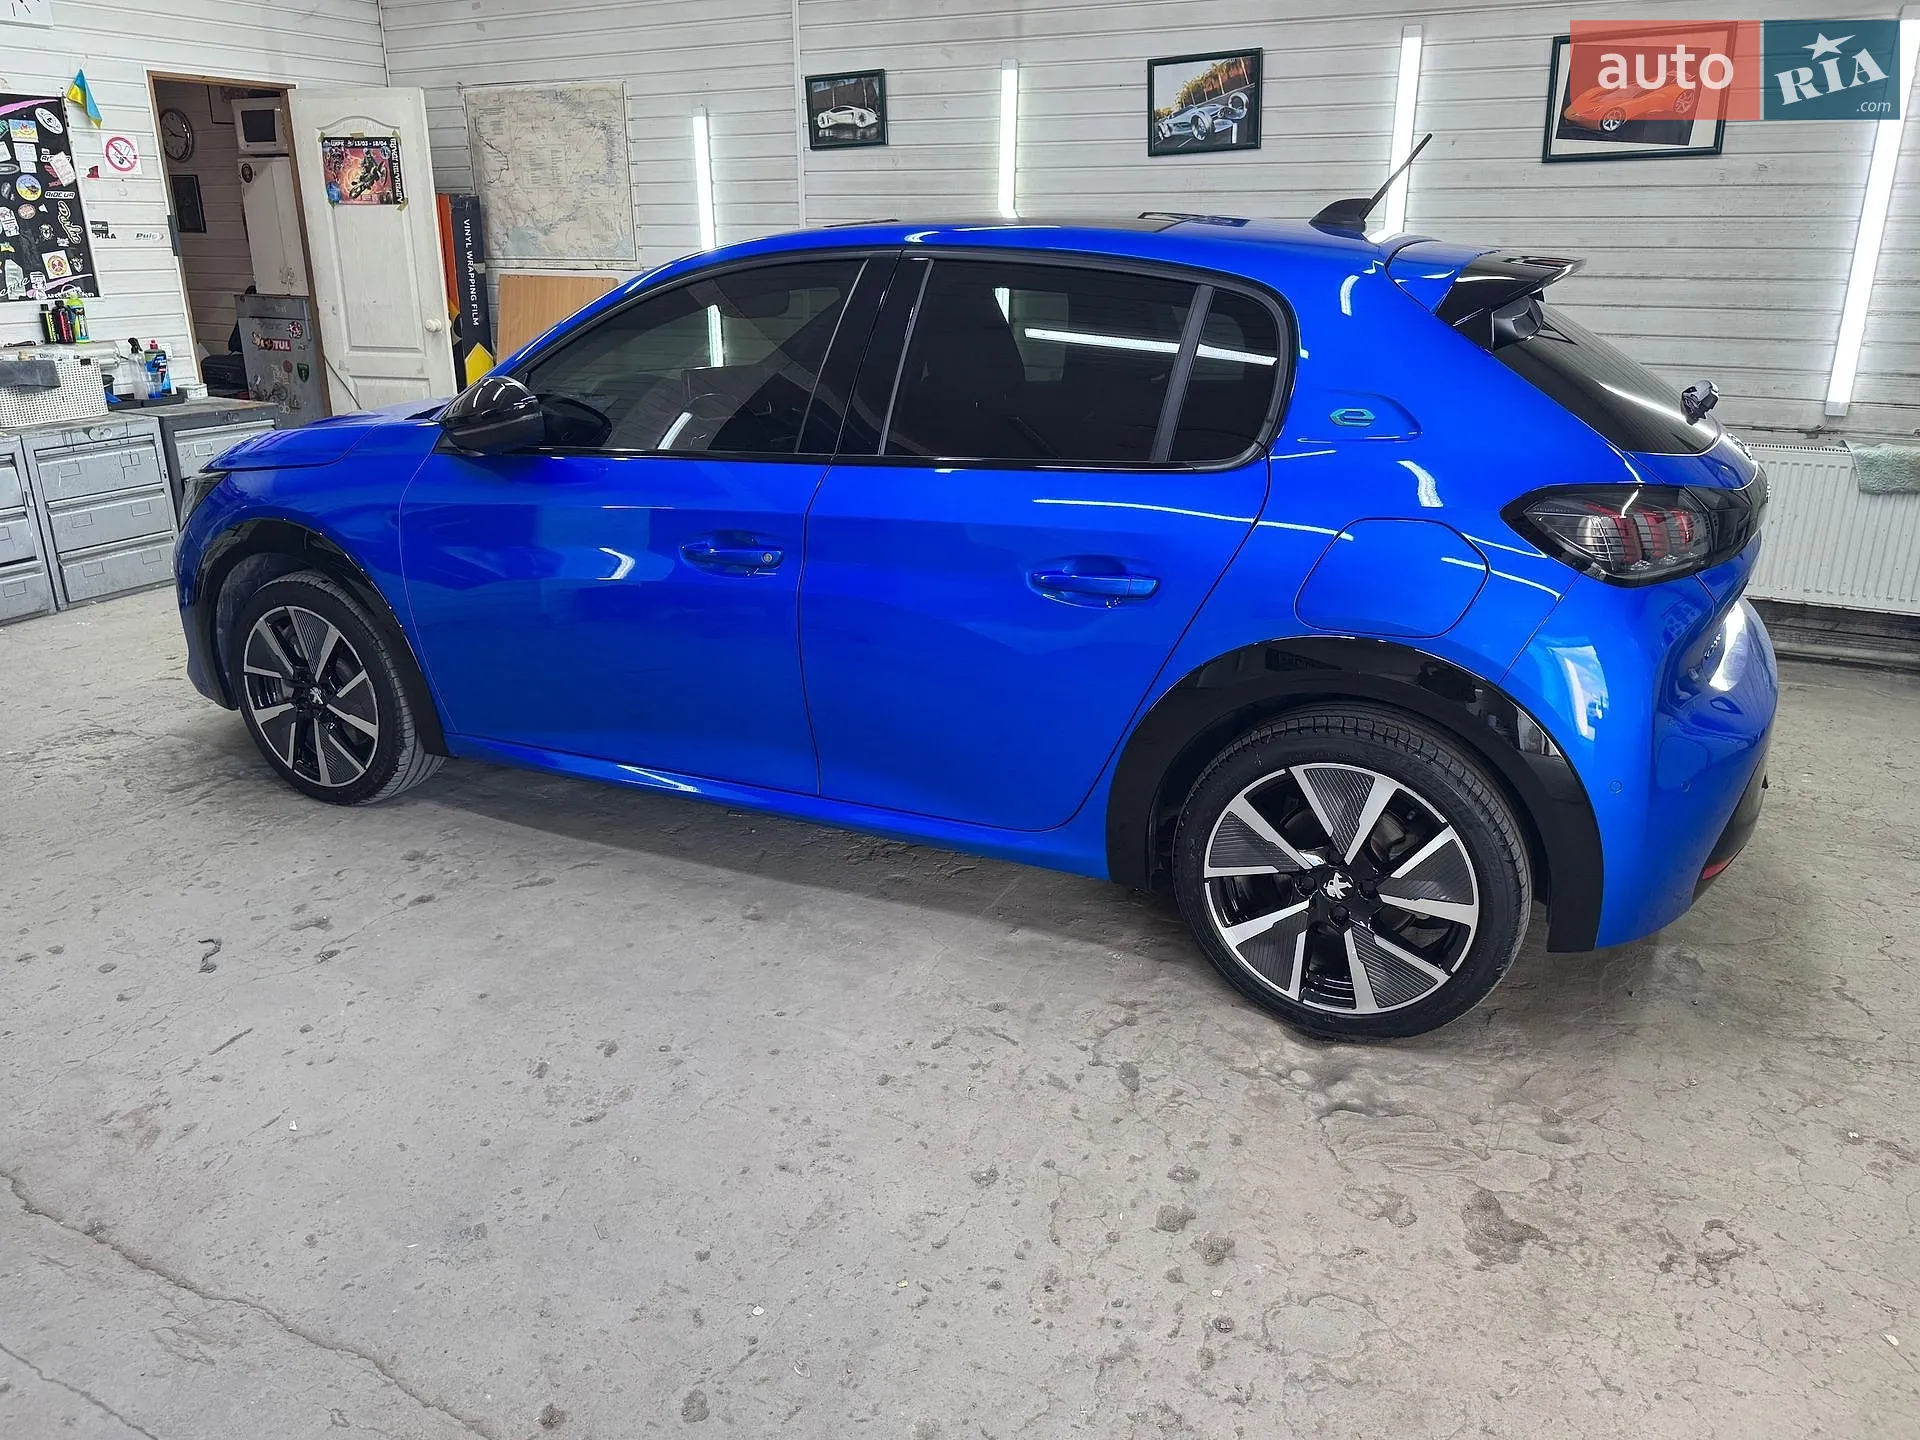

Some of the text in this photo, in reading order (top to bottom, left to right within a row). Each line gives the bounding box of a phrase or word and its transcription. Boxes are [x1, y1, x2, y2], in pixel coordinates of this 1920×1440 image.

[463, 218, 480, 326] VINYL WRAPPING FILM
